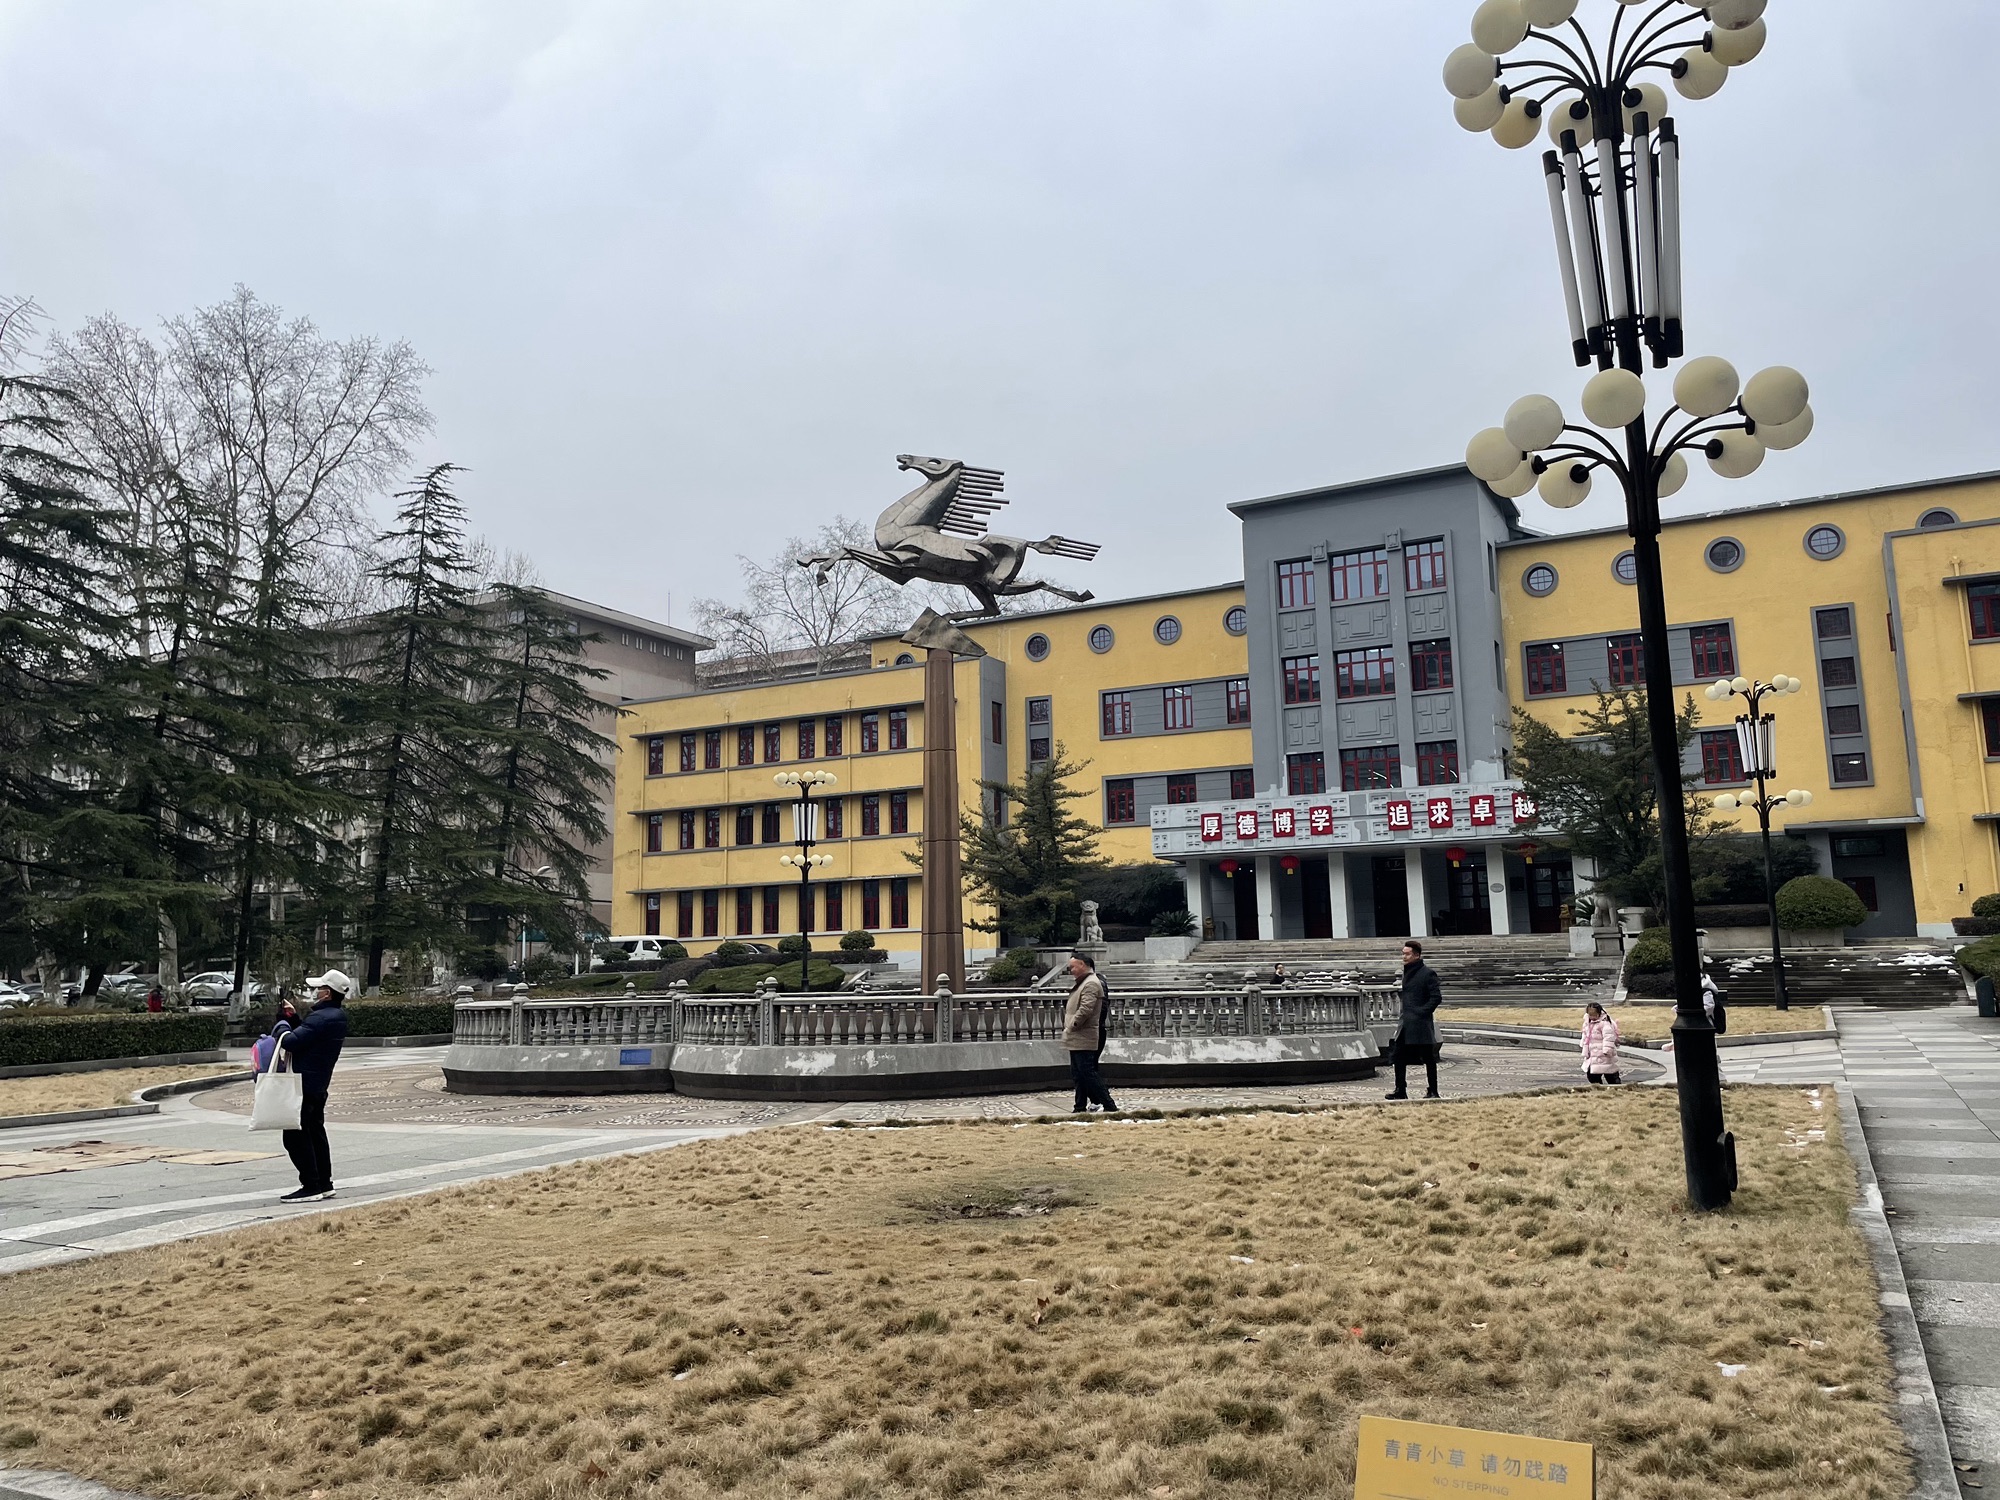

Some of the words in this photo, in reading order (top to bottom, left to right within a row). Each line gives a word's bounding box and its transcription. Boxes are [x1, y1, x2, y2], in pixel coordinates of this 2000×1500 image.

[1203, 809, 1330, 837] 厚德博学
[1389, 796, 1536, 826] 追求卓越
[1385, 1439, 1466, 1468] 青青小草
[1480, 1453, 1568, 1484] 请勿践踏
[1432, 1476, 1449, 1486] NO
[1452, 1479, 1509, 1496] STEPPING
